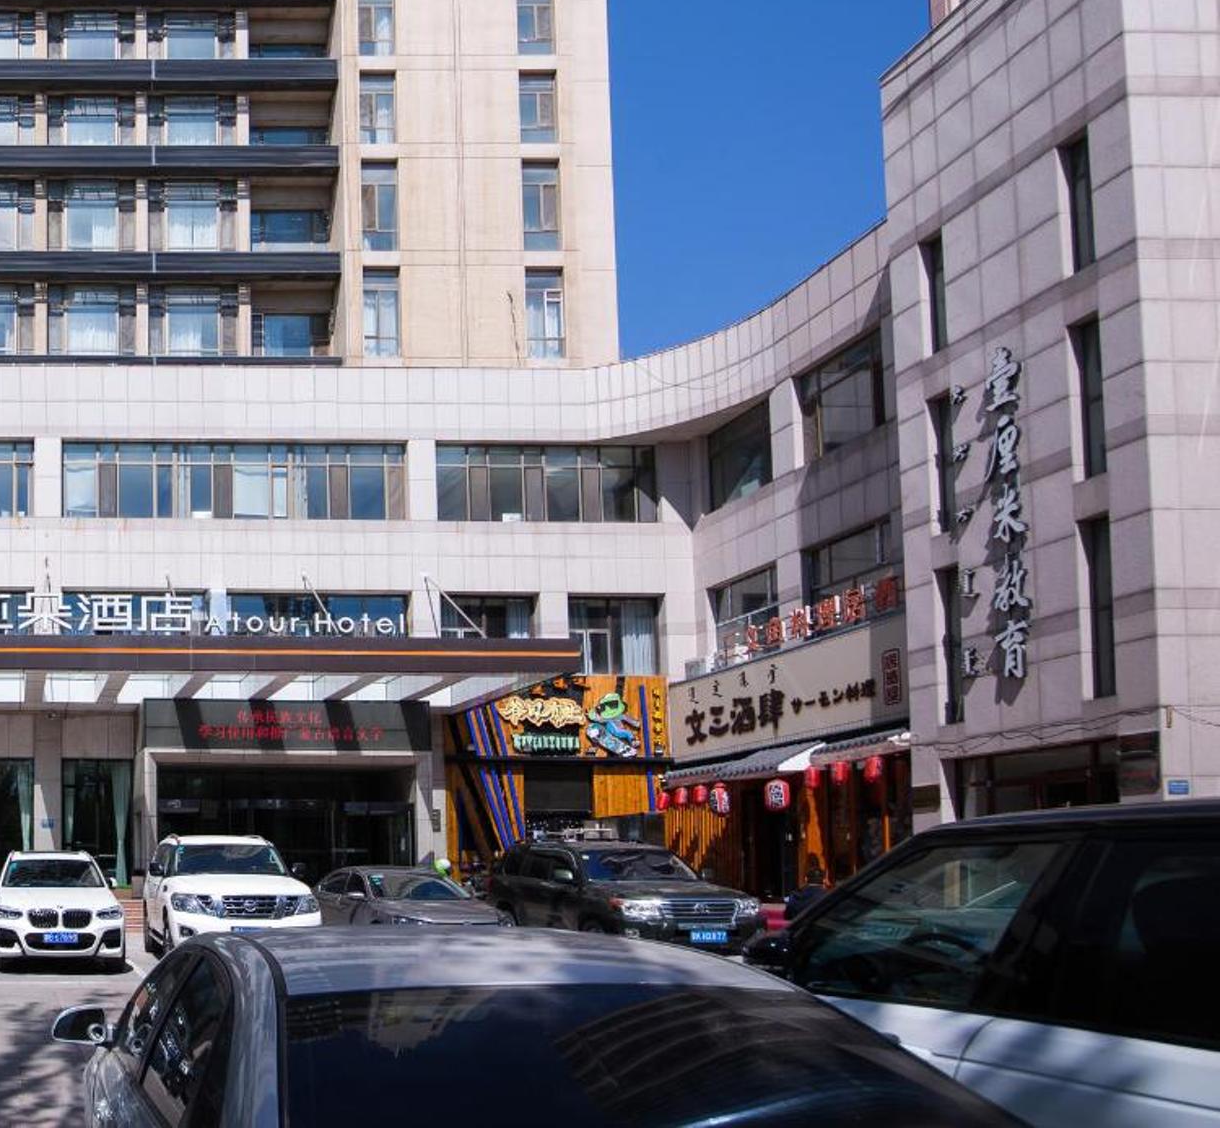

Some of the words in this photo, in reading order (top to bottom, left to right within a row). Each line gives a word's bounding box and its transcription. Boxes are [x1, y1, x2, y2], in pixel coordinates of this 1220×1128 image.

[984, 346, 1031, 679] 壹厘米教育
[205, 614, 301, 635] Atour
[314, 612, 406, 635] Hotel
